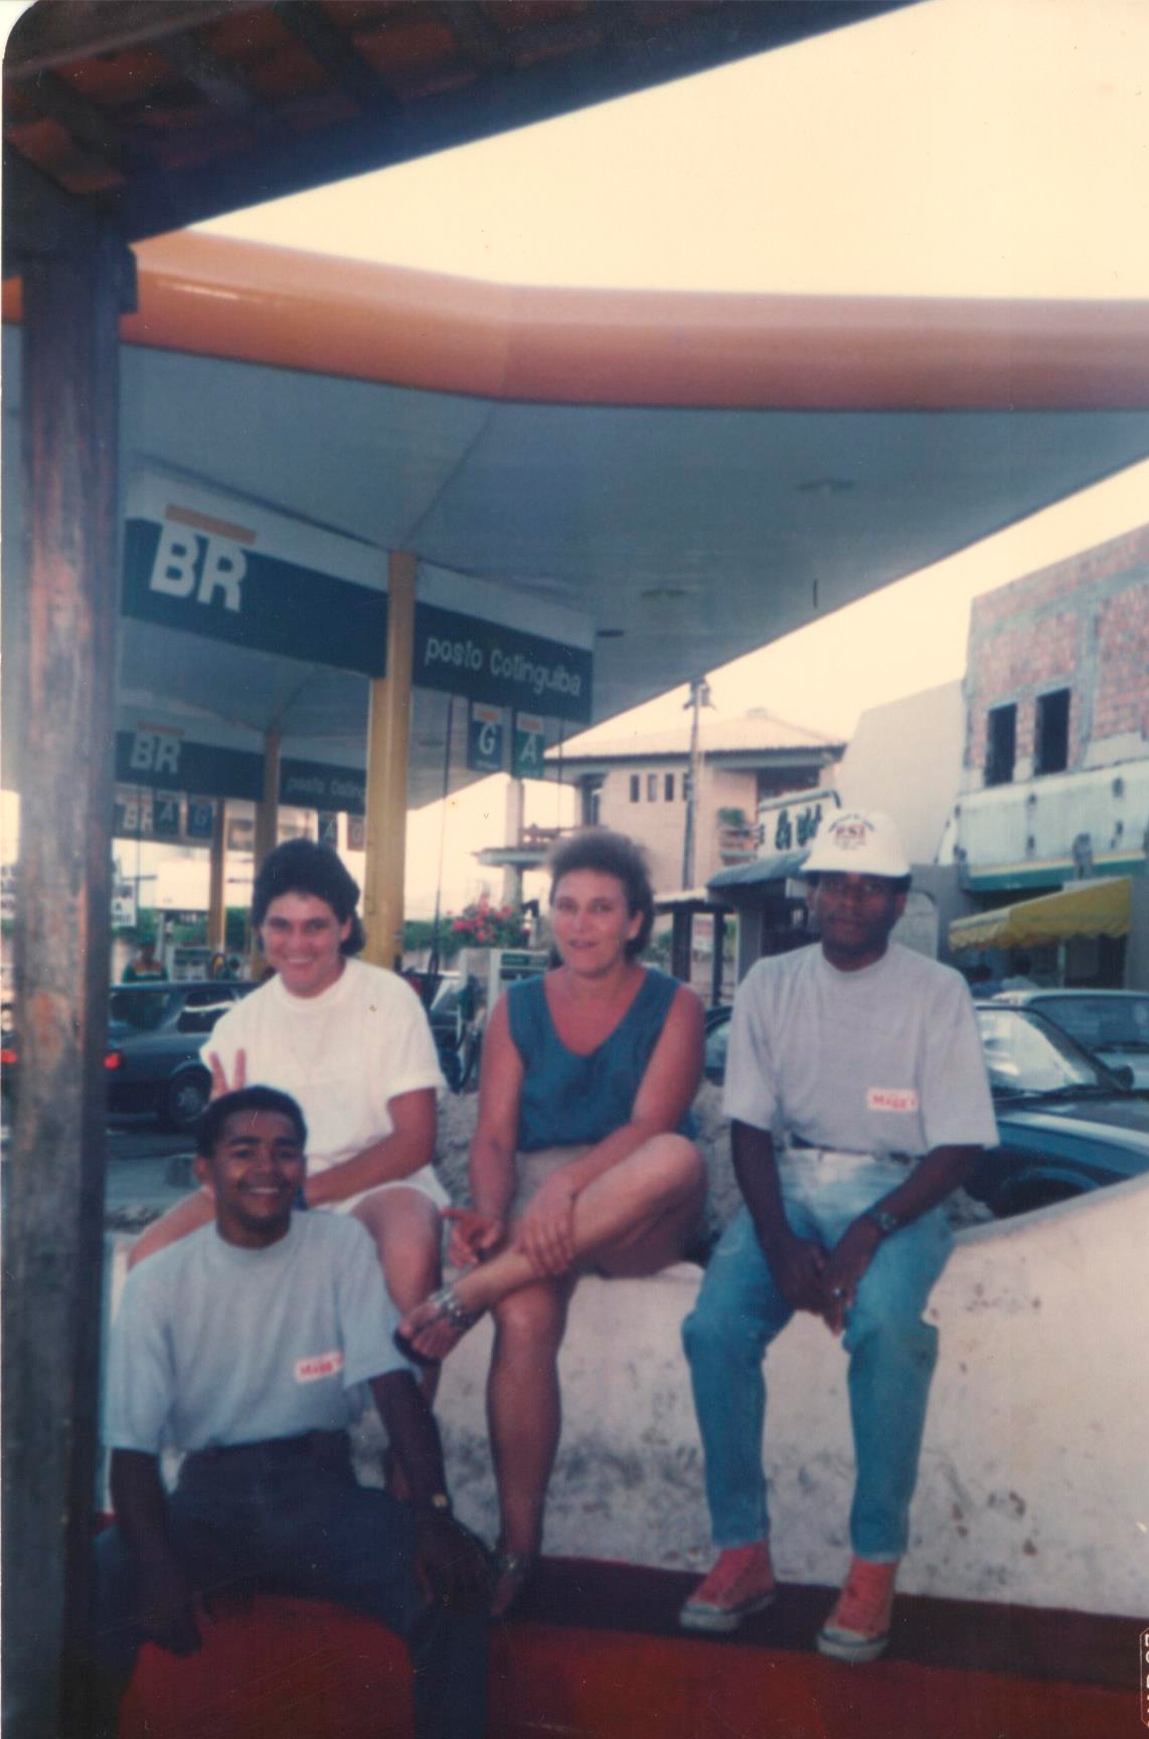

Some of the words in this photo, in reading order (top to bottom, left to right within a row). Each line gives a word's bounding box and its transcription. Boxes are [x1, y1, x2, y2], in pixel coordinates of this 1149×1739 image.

[149, 525, 248, 613] BR
[424, 636, 484, 671] posto
[490, 648, 583, 697] Cotinguiba
[130, 734, 182, 775] BR
[478, 723, 498, 755] G
[519, 732, 538, 764] A
